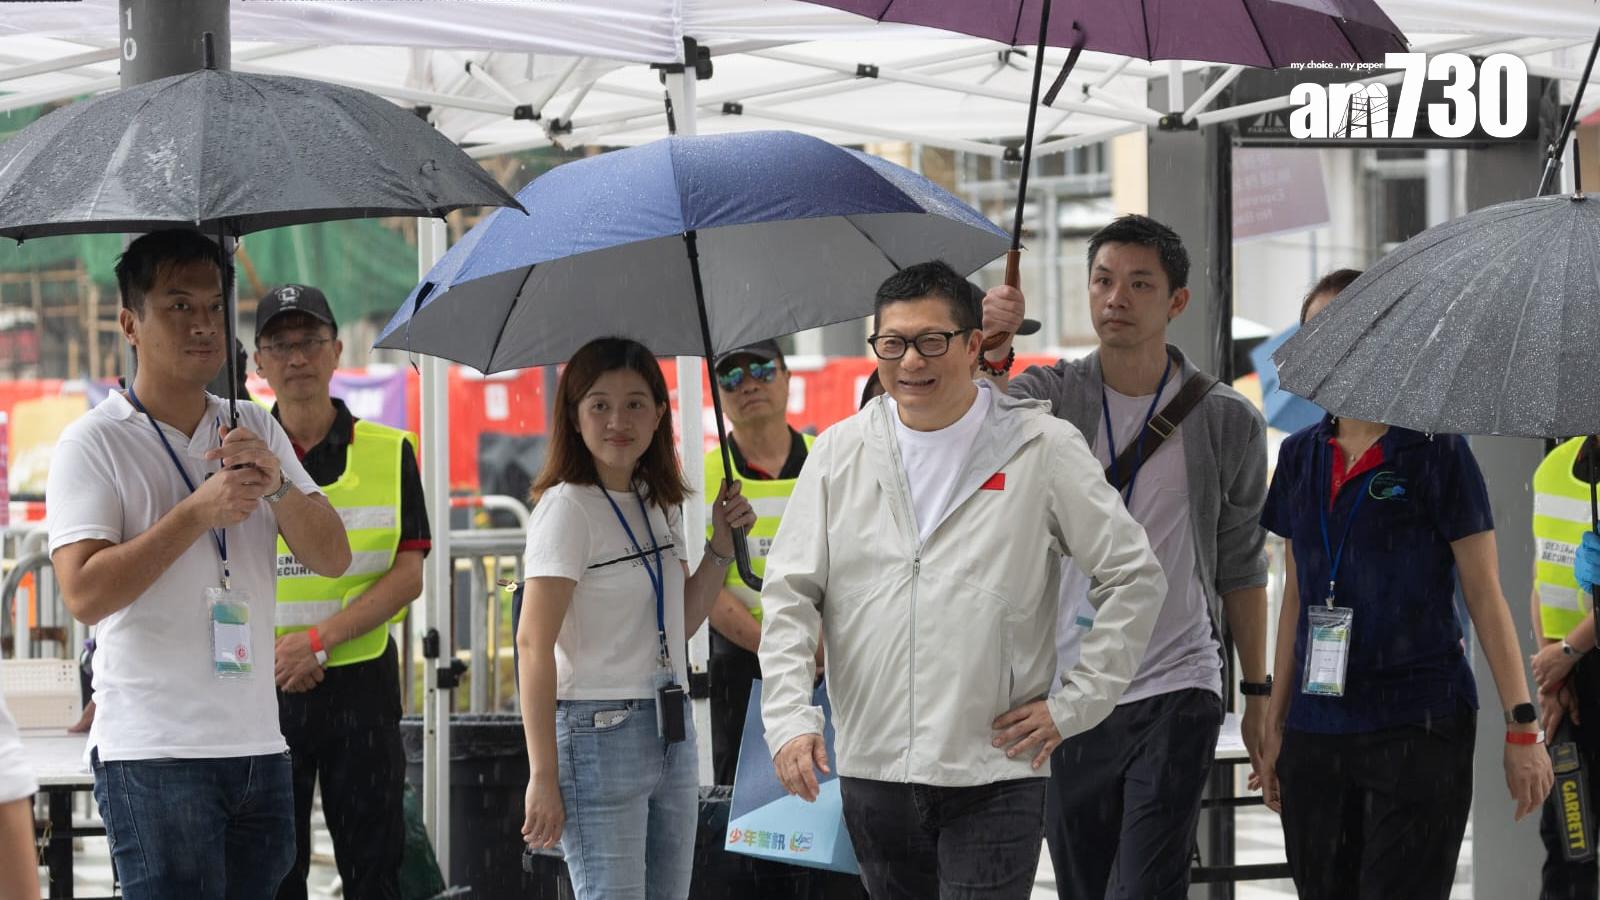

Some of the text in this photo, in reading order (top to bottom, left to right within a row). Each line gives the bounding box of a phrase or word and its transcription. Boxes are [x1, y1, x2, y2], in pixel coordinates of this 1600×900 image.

[1563, 781, 1585, 849] GARRETT
[729, 828, 786, 850] 少年警訊
